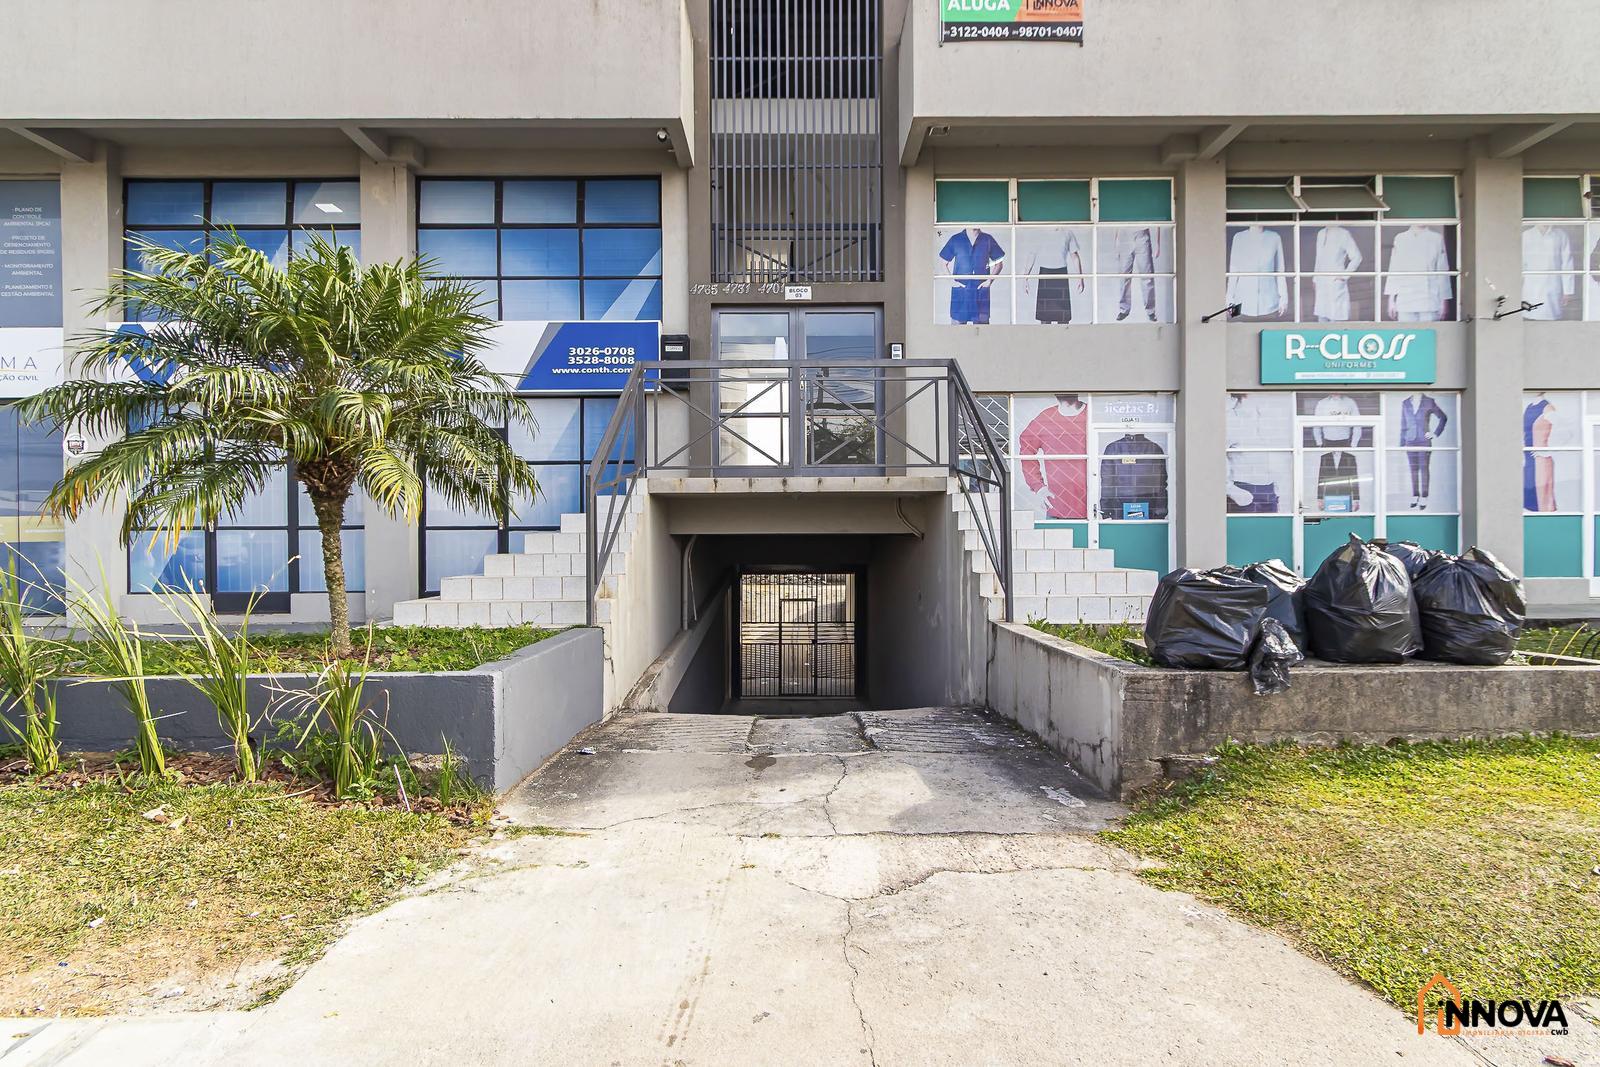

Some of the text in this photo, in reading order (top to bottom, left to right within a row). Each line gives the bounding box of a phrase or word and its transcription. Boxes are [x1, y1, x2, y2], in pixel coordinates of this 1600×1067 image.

[947, 0, 1011, 11] ALUGA
[950, 26, 1009, 37] 3122-0404
[1018, 26, 1083, 37] 98701-0407
[569, 347, 635, 356] 3026-0708
[567, 356, 635, 365] 3528-8008
